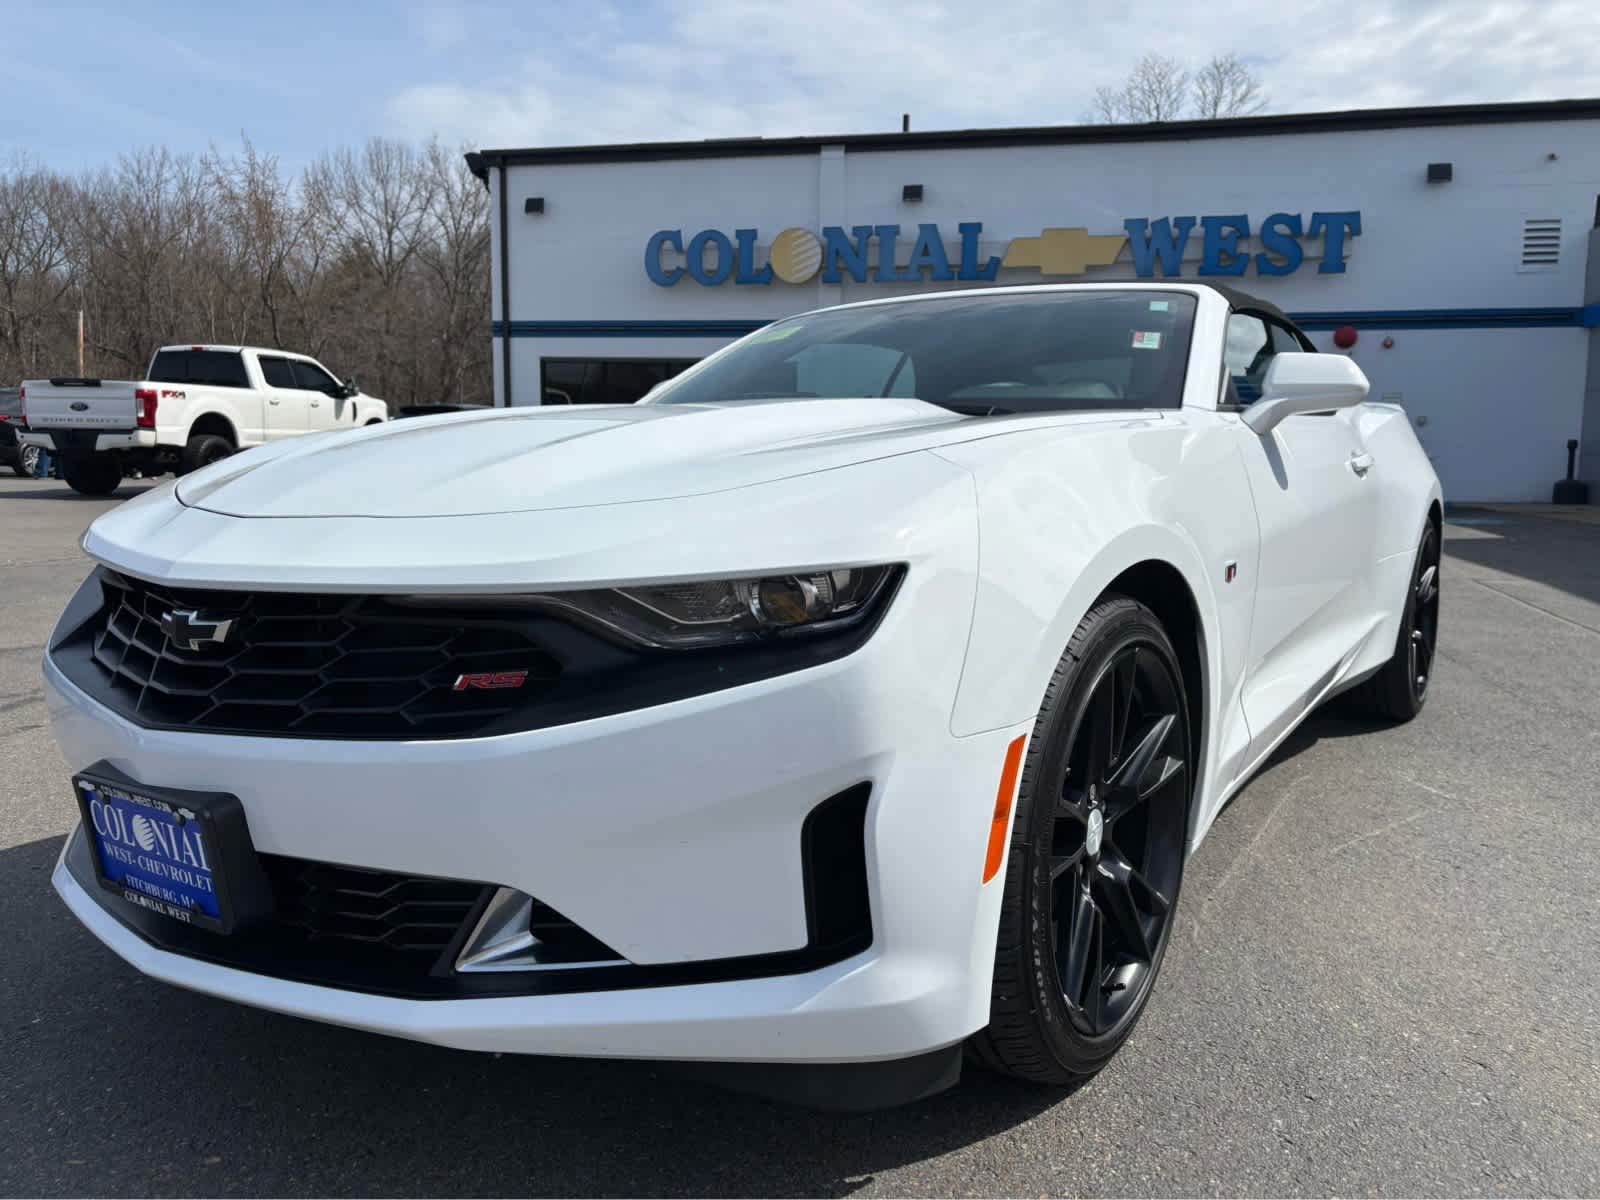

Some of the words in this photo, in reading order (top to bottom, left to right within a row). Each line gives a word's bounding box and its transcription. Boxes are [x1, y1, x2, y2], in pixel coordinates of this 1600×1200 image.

[645, 222, 1001, 287] COLONIAL
[1123, 210, 1362, 277] WEST
[452, 670, 529, 691] RS
[90, 799, 212, 872] COLONIAL
[167, 904, 192, 924] WEST
